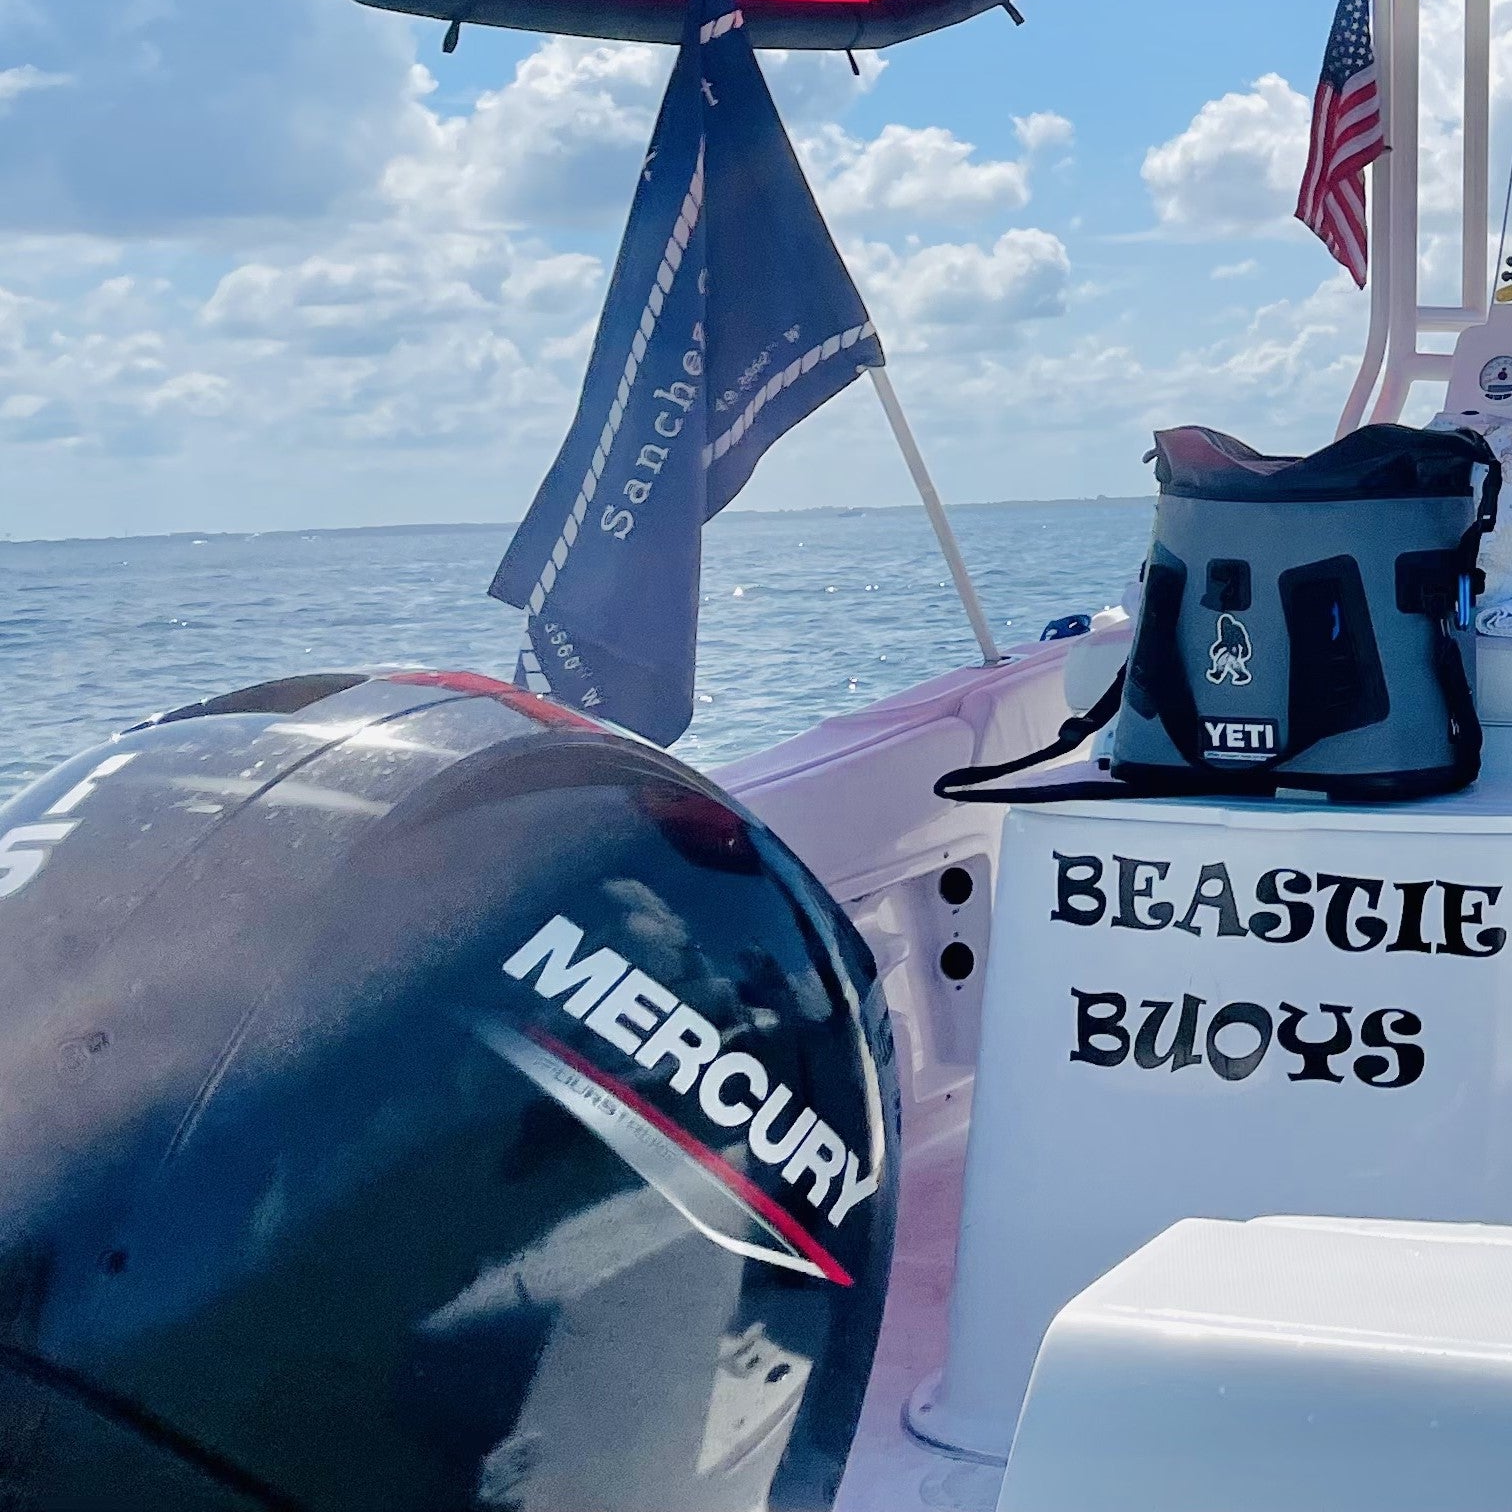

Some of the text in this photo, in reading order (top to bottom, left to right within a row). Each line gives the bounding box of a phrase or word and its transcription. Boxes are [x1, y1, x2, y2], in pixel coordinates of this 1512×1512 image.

[1204, 721, 1274, 749] YETI
[1050, 850, 1508, 958] BEASTIE
[502, 914, 879, 1228] MERCURY
[1069, 987, 1425, 1088] BUOYS
